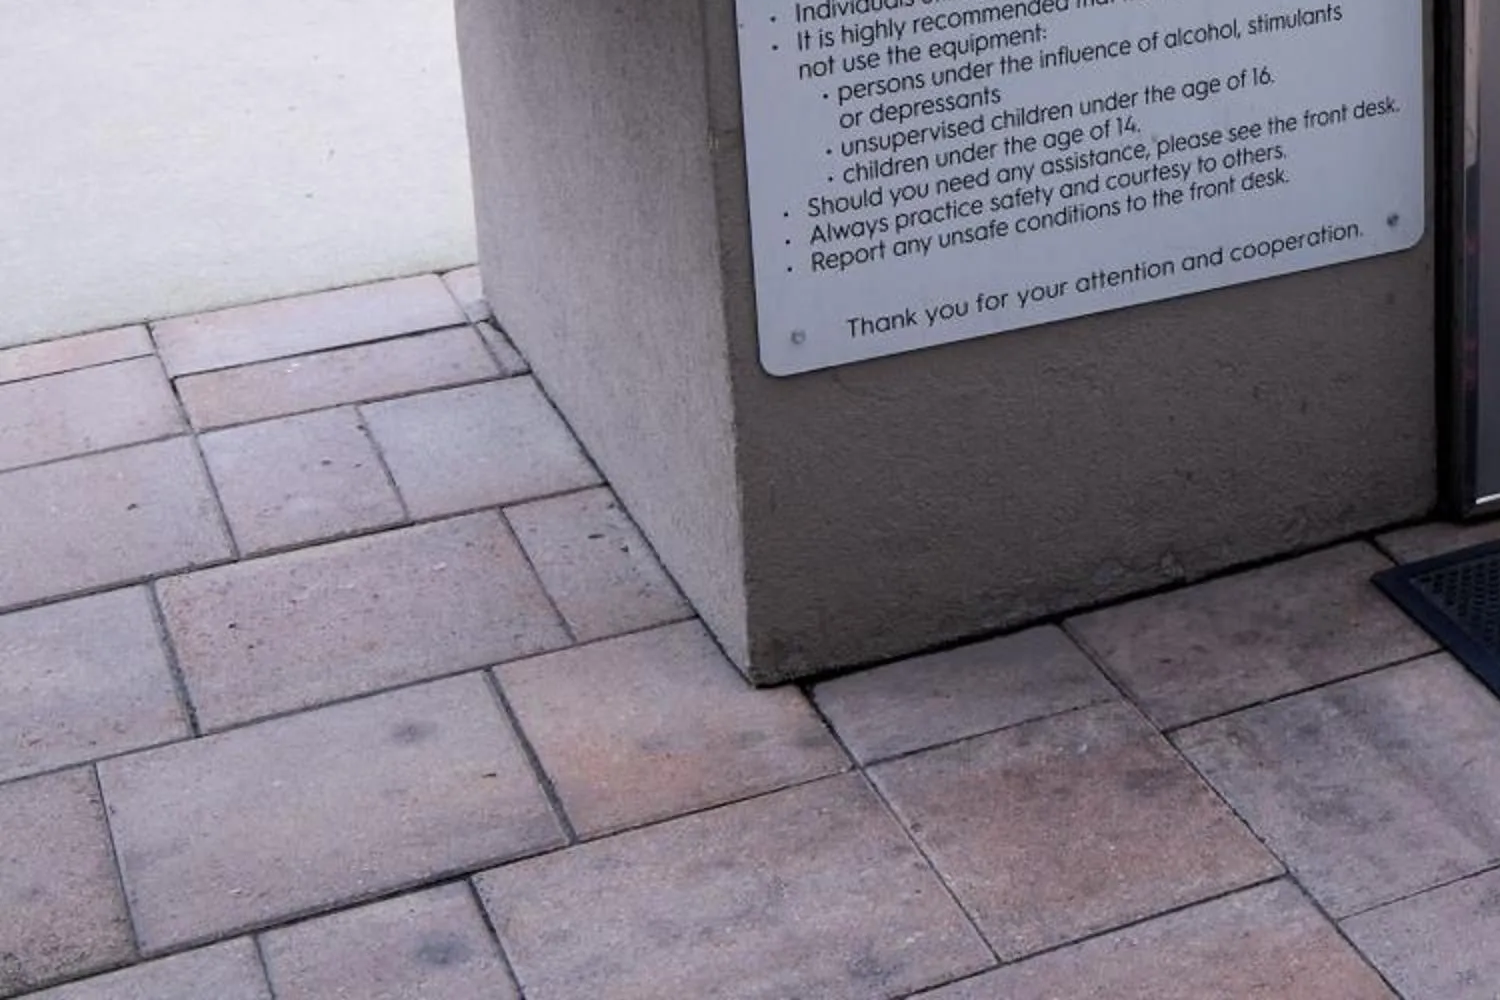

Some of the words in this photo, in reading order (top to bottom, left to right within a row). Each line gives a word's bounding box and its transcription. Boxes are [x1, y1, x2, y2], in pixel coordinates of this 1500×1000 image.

[797, 29, 813, 52] It
[817, 27, 835, 49] is
[840, 17, 907, 48] highly
[798, 55, 836, 81] not
[842, 51, 881, 73] use
[886, 44, 922, 66] the
[927, 22, 1047, 62] equipment:
[837, 72, 926, 107] persons
[930, 60, 995, 87] under
[999, 54, 1034, 76] the
[1039, 39, 1132, 69] influence
[1137, 31, 1160, 53] of
[1163, 17, 1242, 49] alcohol,
[1247, 3, 1343, 35] stimulants
[839, 110, 864, 129] or
[868, 85, 1002, 126] depressants
[841, 113, 985, 158] unsupervised
[990, 103, 1074, 132] children
[1079, 91, 1139, 116] under
[1143, 84, 1177, 105] the
[1181, 77, 1221, 102] age
[1225, 68, 1248, 92] of
[1252, 65, 1276, 87] 16.
[842, 155, 930, 185] children
[935, 142, 999, 169] under
[1002, 135, 1038, 157] the
[1042, 127, 1086, 153] age
[1088, 118, 1111, 142] of
[1115, 114, 1141, 137] 14.
[807, 185, 884, 218] Should
[888, 182, 929, 208] you
[935, 167, 991, 196] need
[994, 162, 1035, 185] any
[1039, 143, 1151, 177] assistance,
[1156, 131, 1224, 161] please
[1225, 123, 1263, 144] see
[1267, 115, 1298, 136] the
[1303, 103, 1349, 129] front
[1352, 96, 1401, 120] desk.
[809, 216, 890, 246] Always
[894, 199, 985, 235] practice
[989, 184, 1055, 213] safety
[1059, 172, 1101, 200] and
[1104, 161, 1192, 191] courtesy
[1197, 155, 1218, 174] to
[1221, 144, 1287, 170] others.
[811, 239, 886, 273] Report
[892, 235, 933, 257] any
[937, 218, 1010, 249] unsafe
[1014, 200, 1122, 234] conditions
[1125, 193, 1147, 214] to
[1151, 187, 1185, 209] the
[1188, 174, 1237, 201] front
[1240, 167, 1290, 192] desk.
[846, 307, 918, 338] Thank
[924, 301, 969, 328] you
[975, 292, 1009, 313] for
[1016, 281, 1069, 309] your
[1075, 260, 1175, 293] attention
[1180, 247, 1224, 272] and
[1229, 223, 1363, 263] cooperation.
